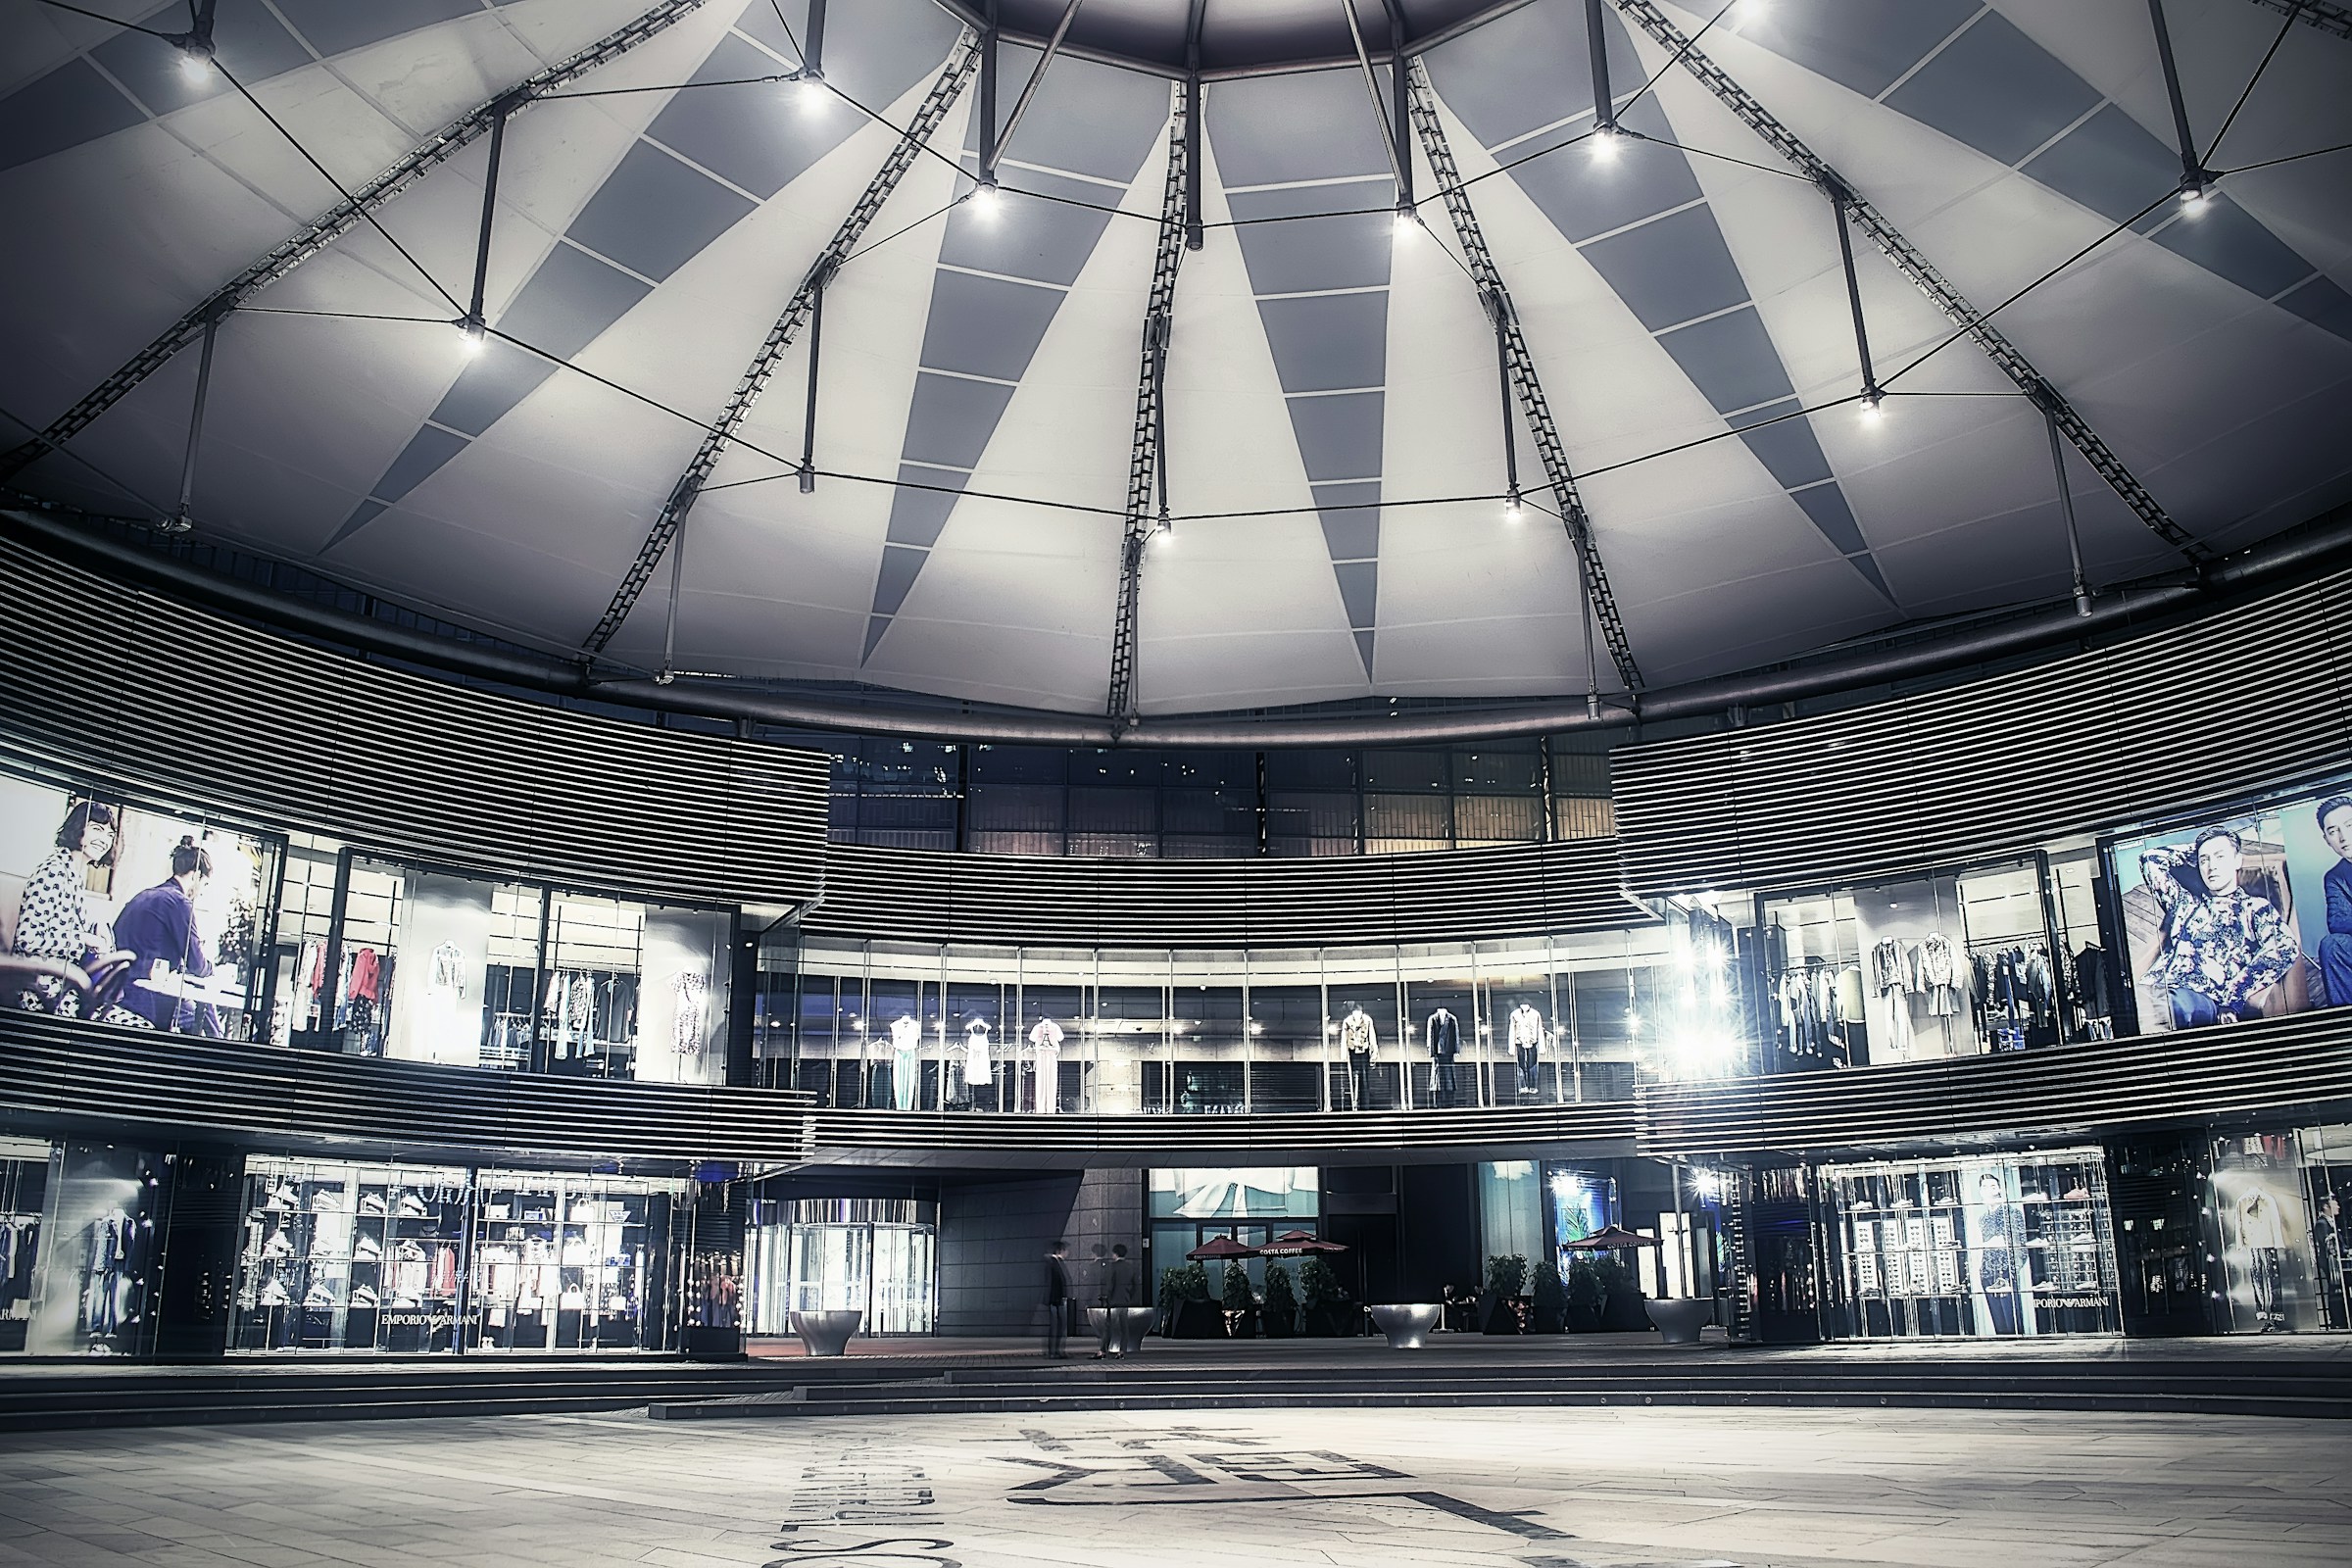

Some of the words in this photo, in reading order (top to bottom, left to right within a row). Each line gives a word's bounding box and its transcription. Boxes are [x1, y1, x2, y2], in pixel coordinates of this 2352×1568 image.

[2074, 1297, 2110, 1308] ARMANI
[381, 1314, 427, 1325] EMPORIO
[440, 1314, 478, 1325] ARMANI
